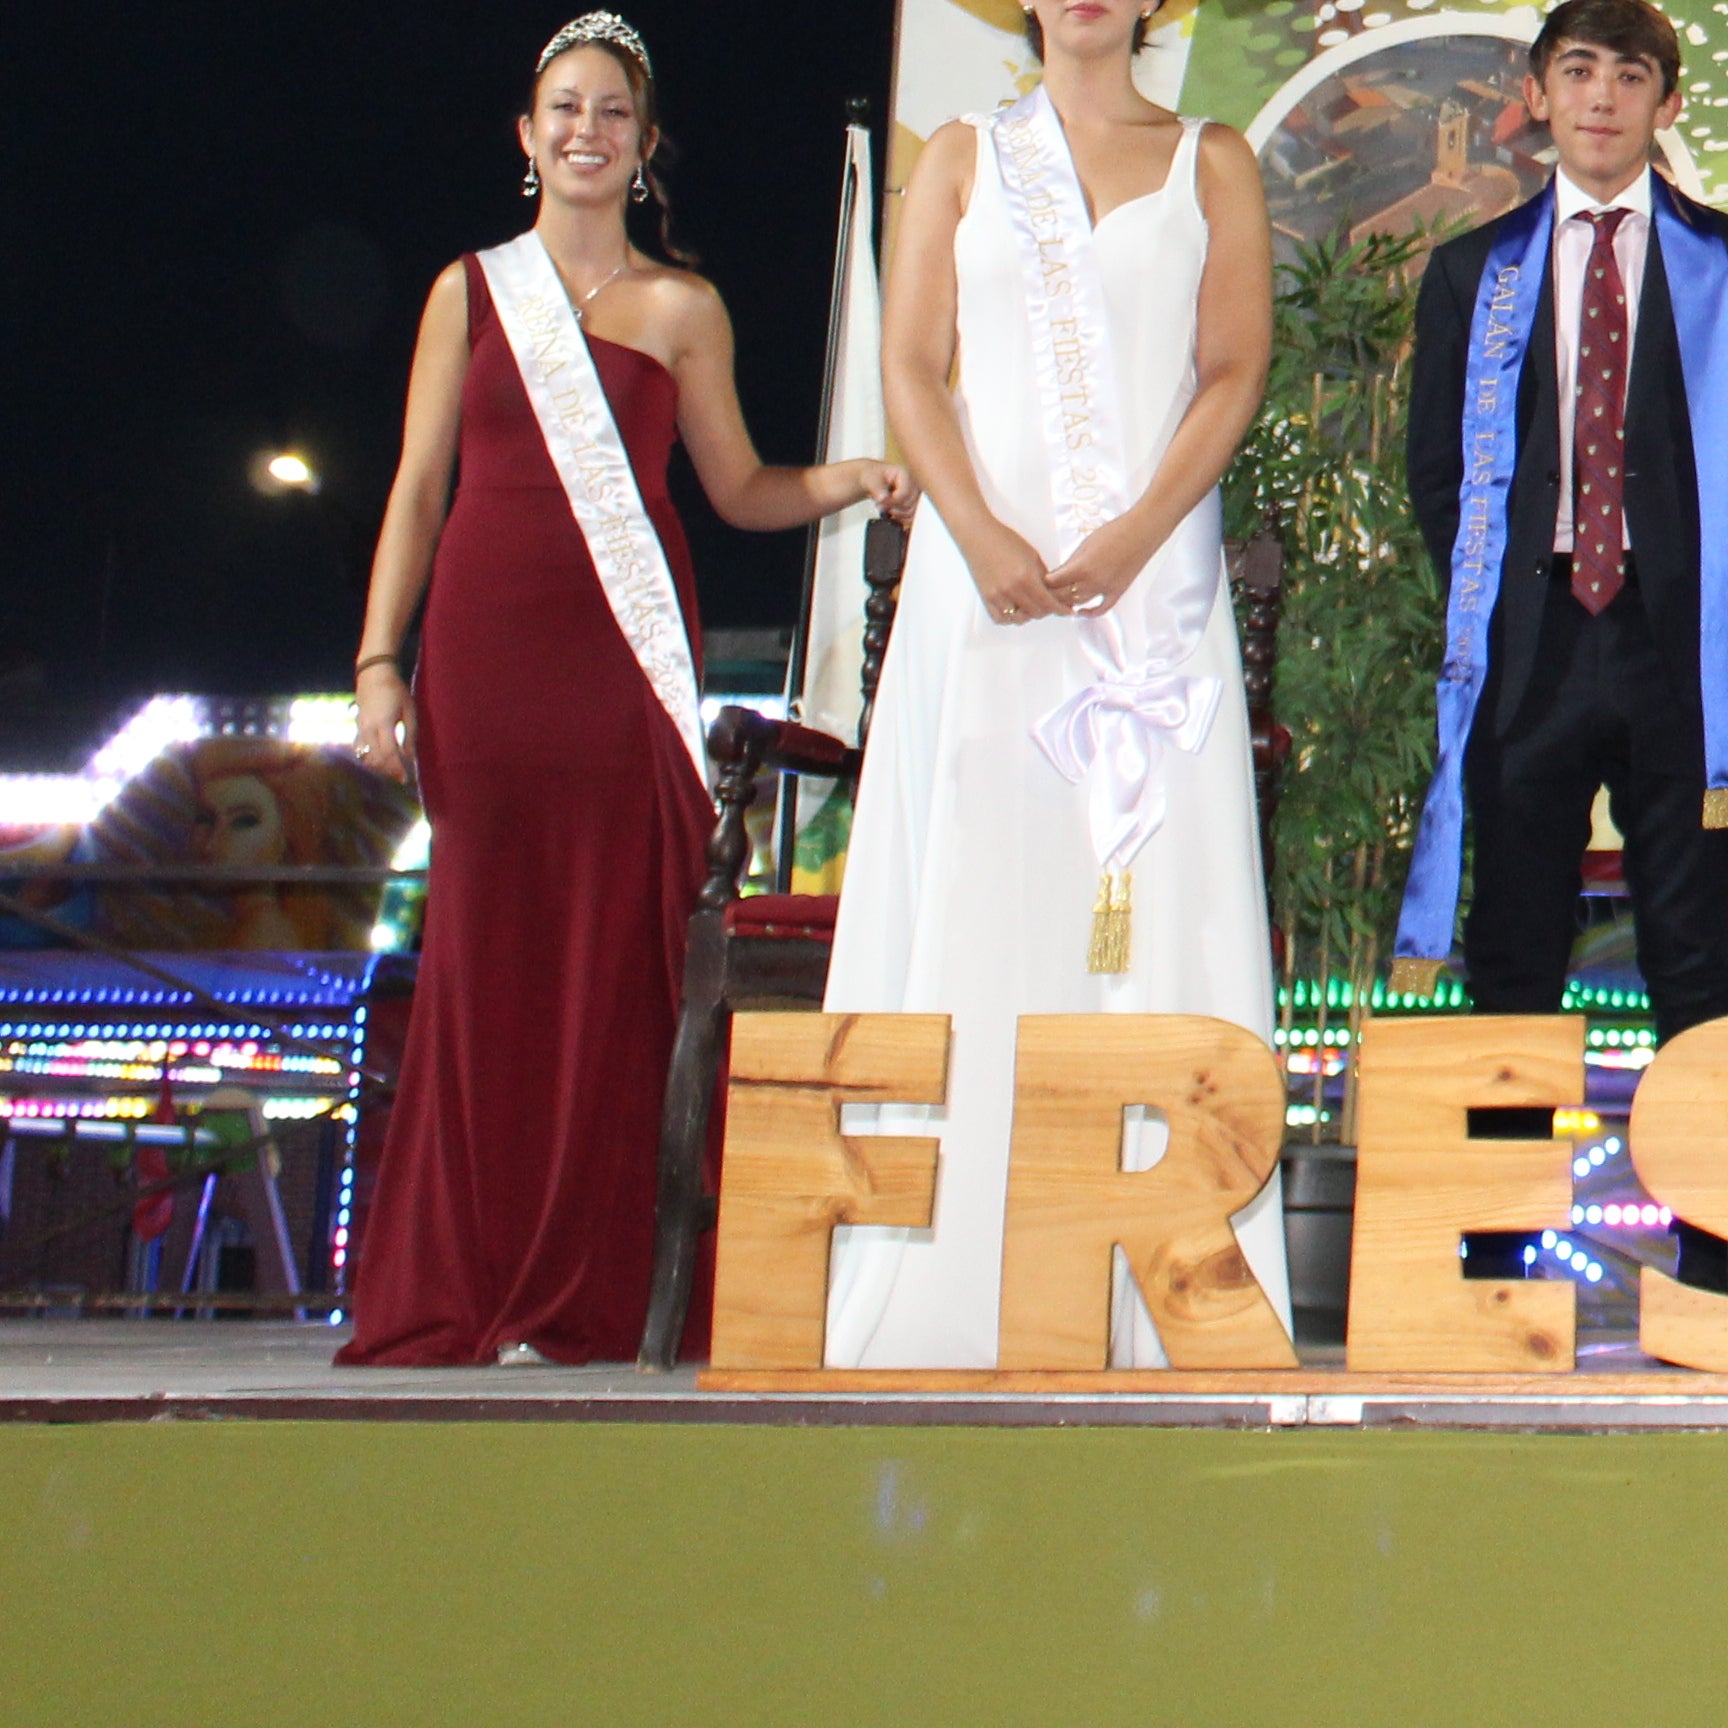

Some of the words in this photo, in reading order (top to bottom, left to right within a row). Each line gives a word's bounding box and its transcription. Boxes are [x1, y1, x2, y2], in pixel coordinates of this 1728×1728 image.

[1028, 193, 1058, 228] DE
[1037, 238, 1072, 297] LAS
[1483, 266, 1520, 359] GALÁN
[1050, 317, 1093, 450] FIESTAS
[1477, 378, 1498, 414] DE
[1472, 432, 1495, 486] LAS
[553, 389, 588, 432] DE
[572, 442, 614, 502] LAS
[601, 515, 662, 642] FIESTAS
[1459, 495, 1489, 613] FIESTAS
